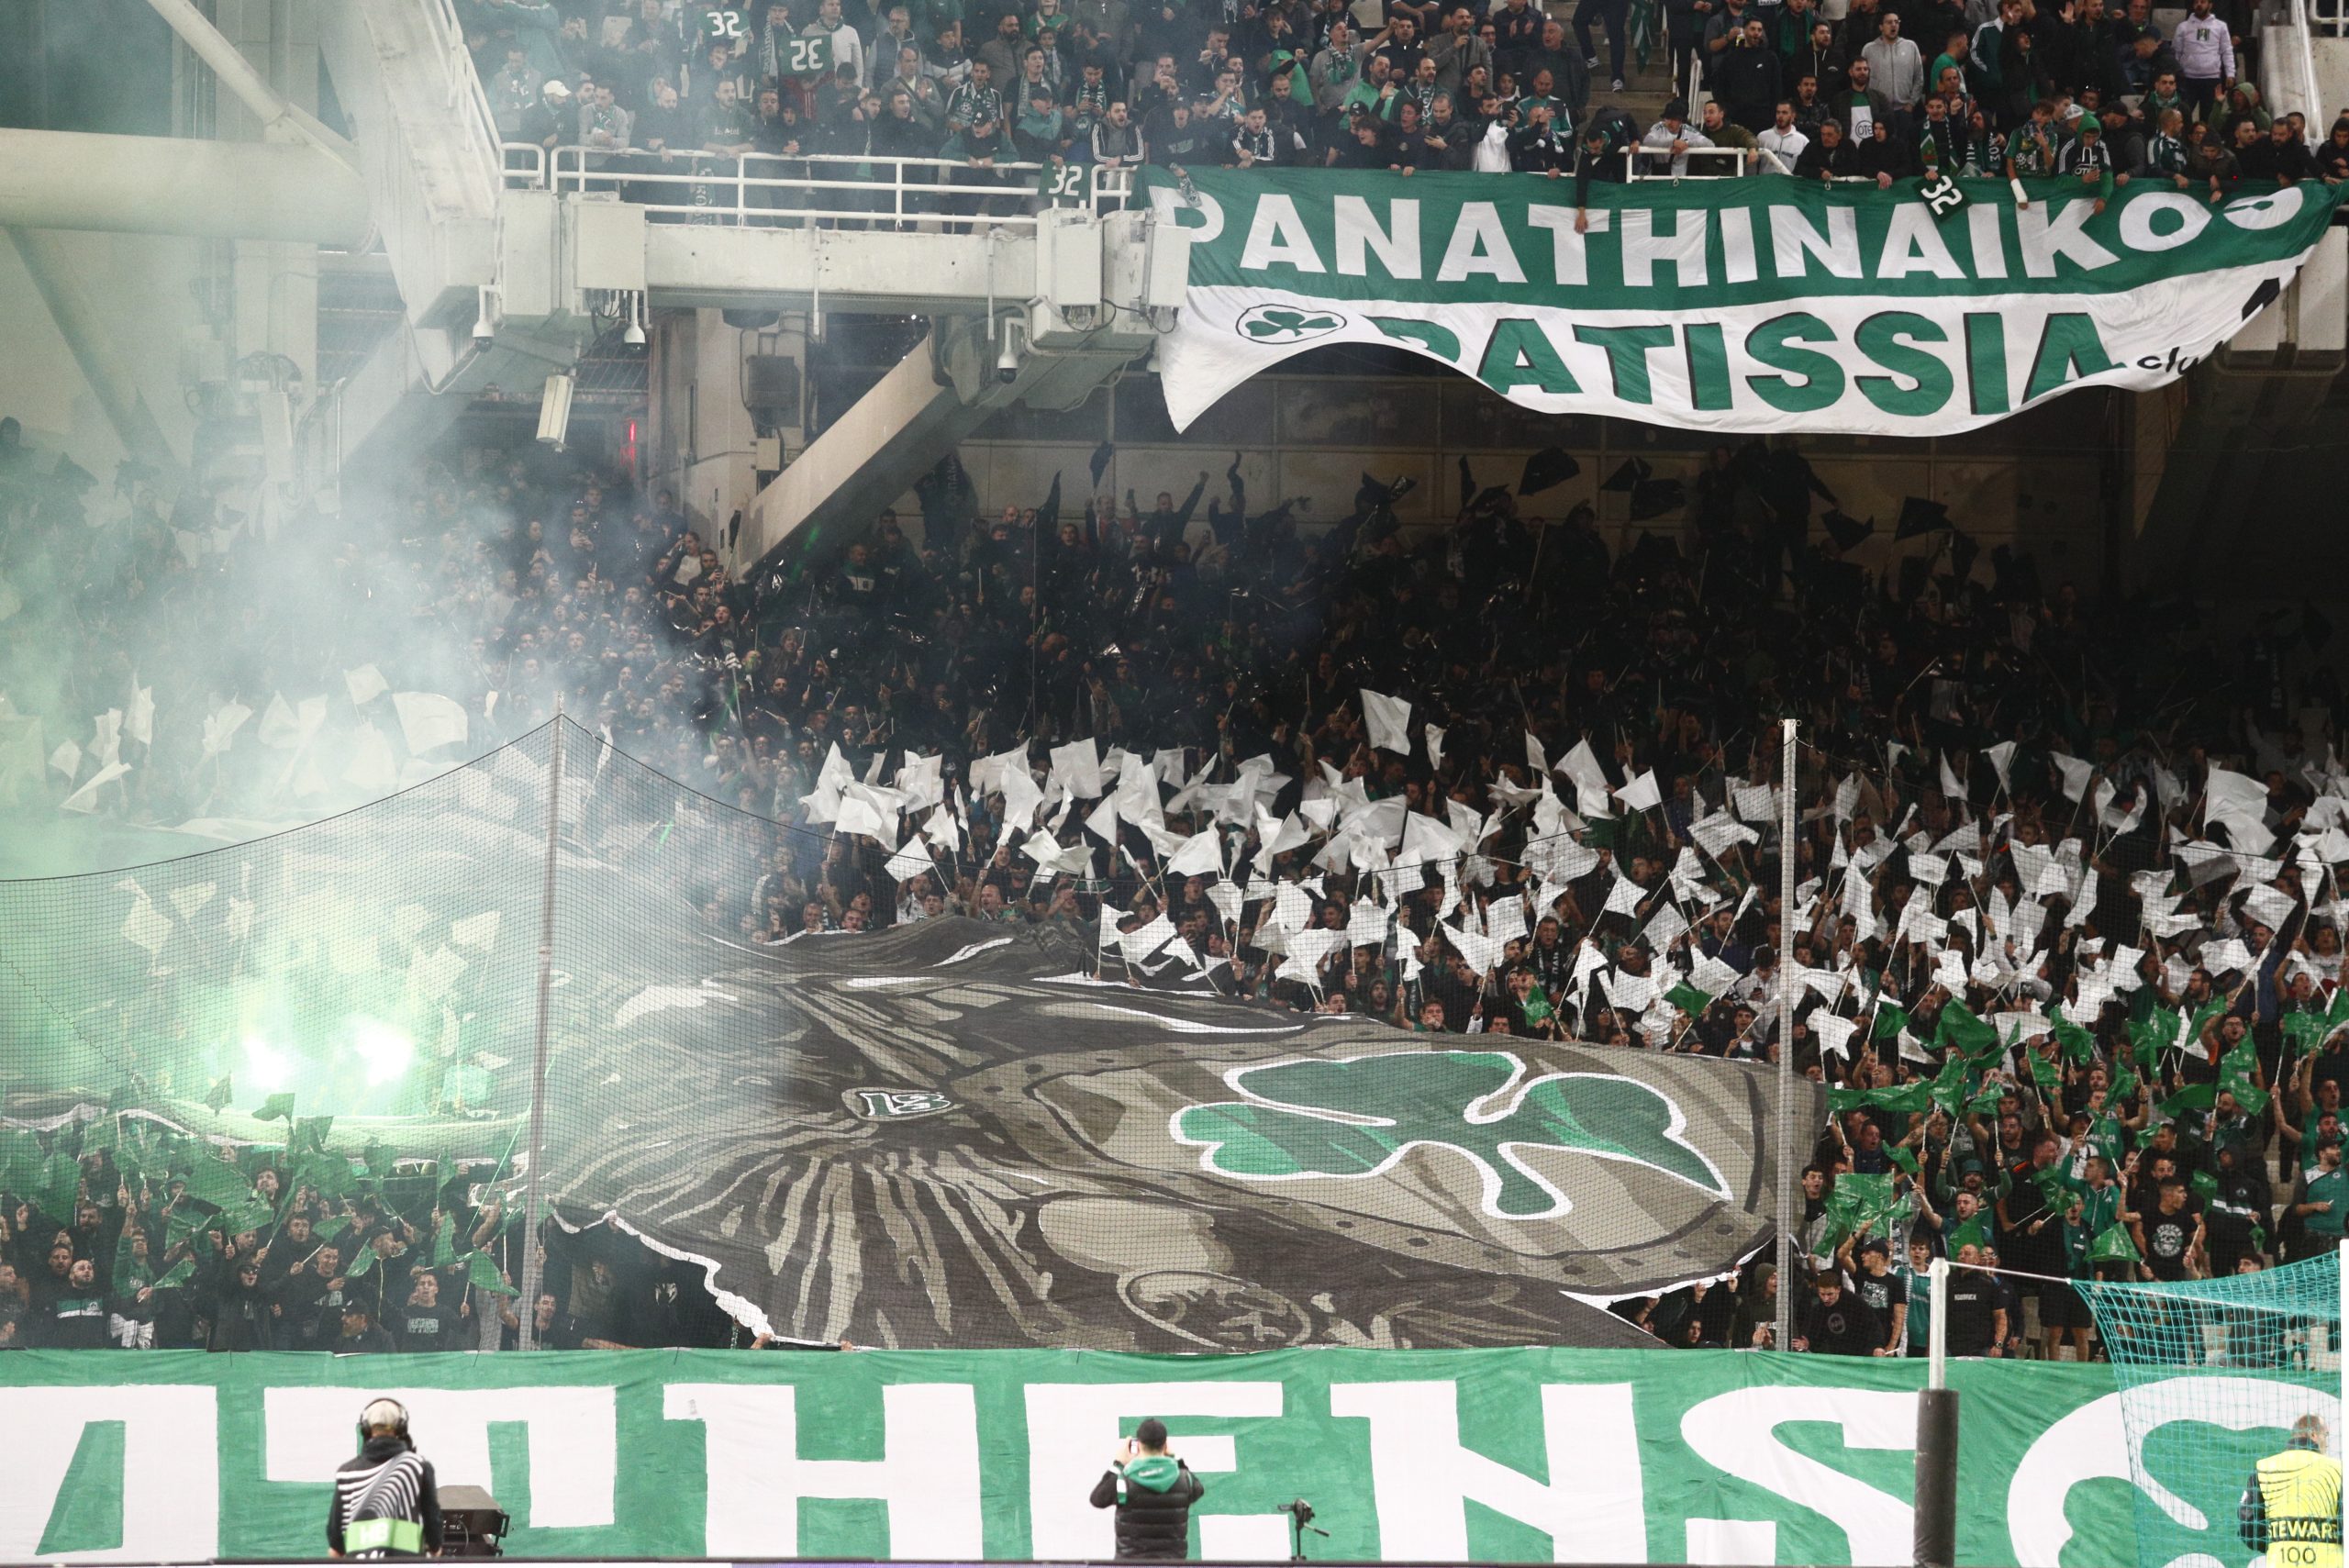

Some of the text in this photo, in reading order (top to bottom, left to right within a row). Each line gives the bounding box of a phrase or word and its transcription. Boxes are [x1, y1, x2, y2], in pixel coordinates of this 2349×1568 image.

[707, 11, 742, 38] 32
[1048, 165, 1083, 196] 32
[1920, 175, 1963, 217] 32
[2137, 340, 2223, 375] clu
[2280, 1547, 2316, 1564] 100
